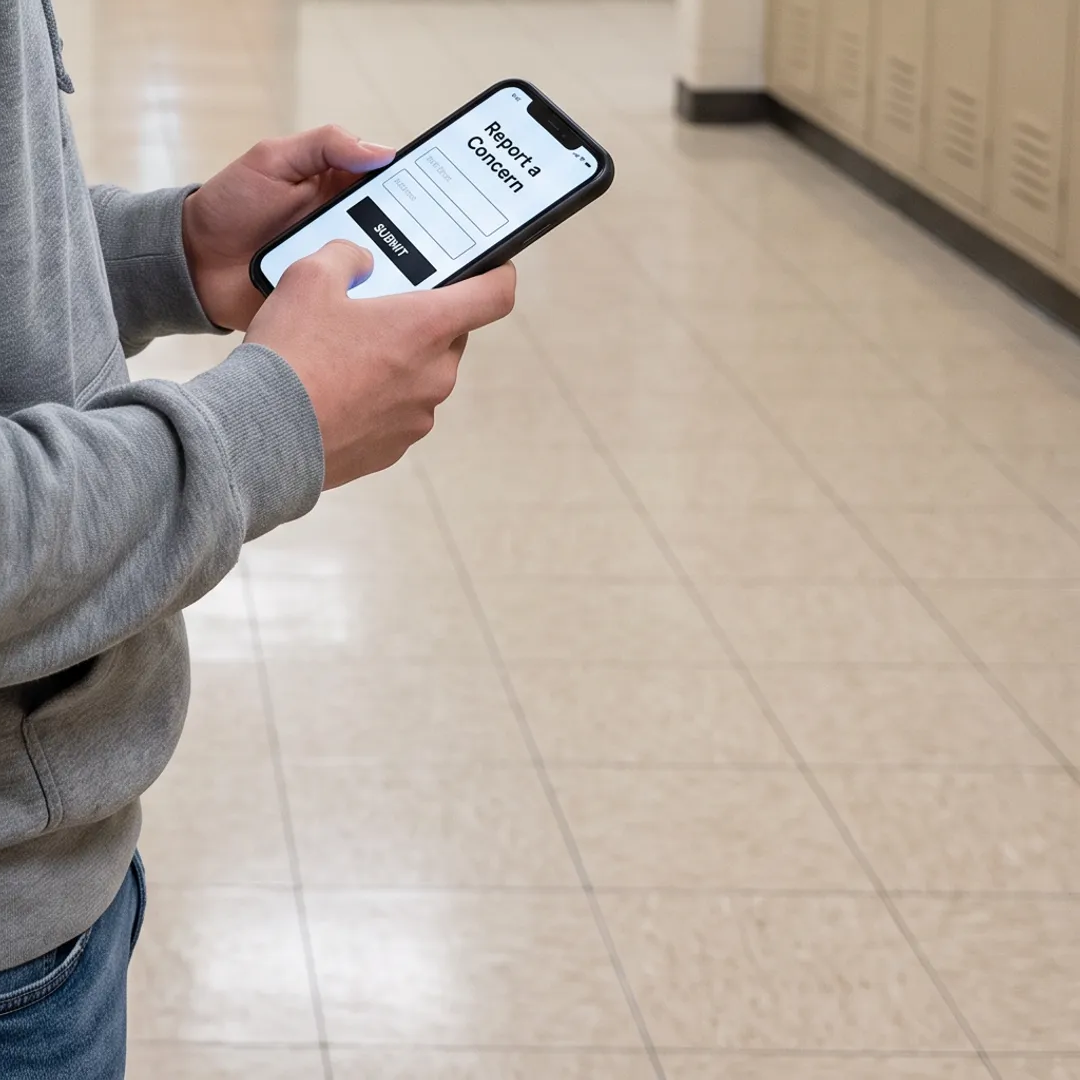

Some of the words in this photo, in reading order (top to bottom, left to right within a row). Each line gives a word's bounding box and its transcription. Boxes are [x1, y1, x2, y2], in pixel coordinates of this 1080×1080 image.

[467, 136, 524, 193] Concern
[484, 121, 533, 168] Report
[528, 166, 541, 177] a
[373, 223, 409, 257] SUBMIT
